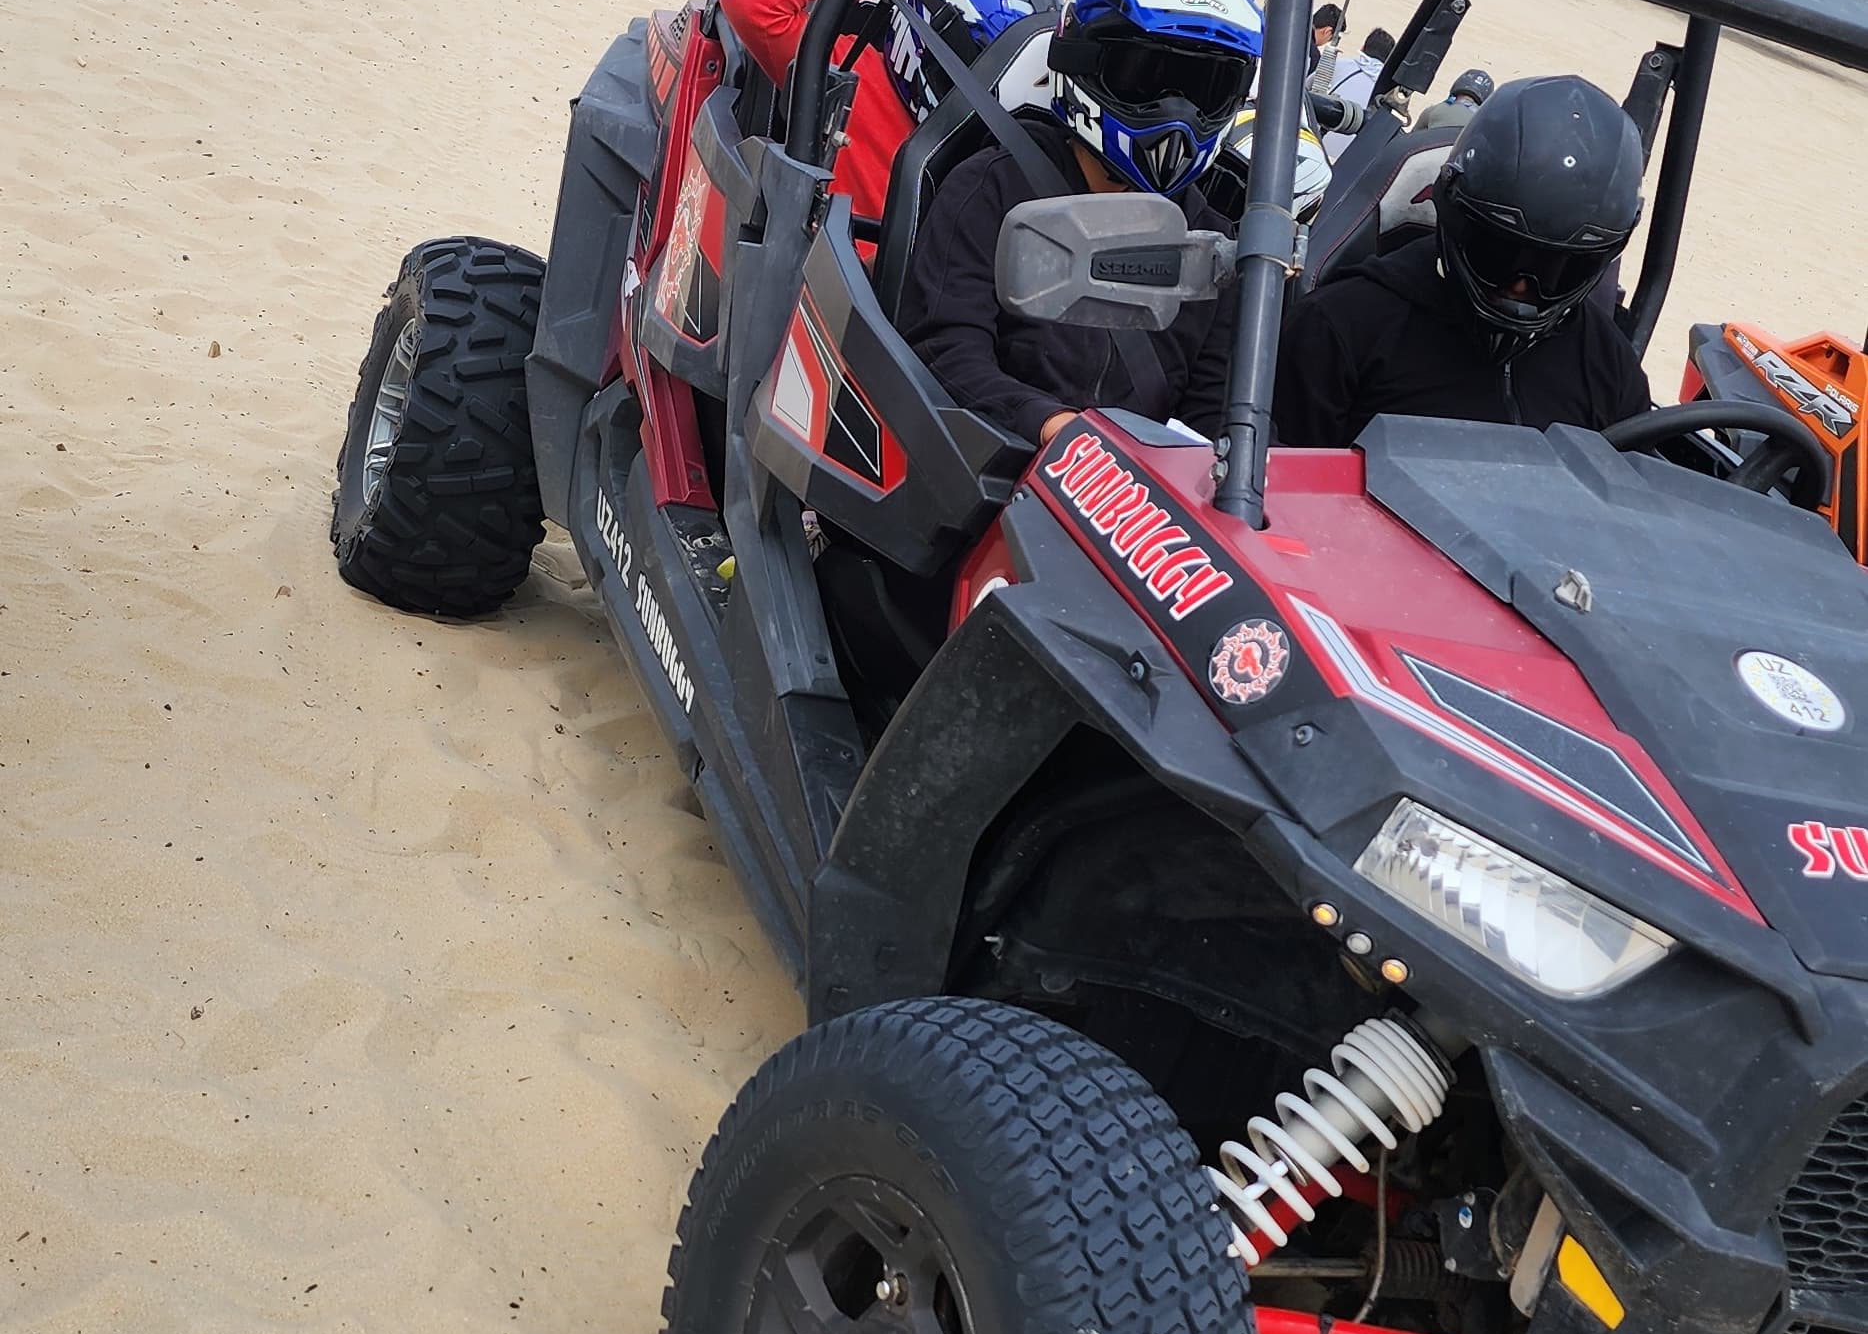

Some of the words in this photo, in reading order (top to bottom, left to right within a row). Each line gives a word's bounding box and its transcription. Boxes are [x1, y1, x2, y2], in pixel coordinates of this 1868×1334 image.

[1098, 262, 1174, 276] SEIZMIK
[1752, 350, 1853, 436] RZR
[1824, 383, 1860, 413] POLARIS
[1045, 432, 1234, 622] SUNBUGGY
[596, 486, 632, 590] UZ412
[635, 571, 696, 715] SUNBUGGY
[1755, 657, 1793, 676] UZ
[1790, 703, 1831, 724] 412
